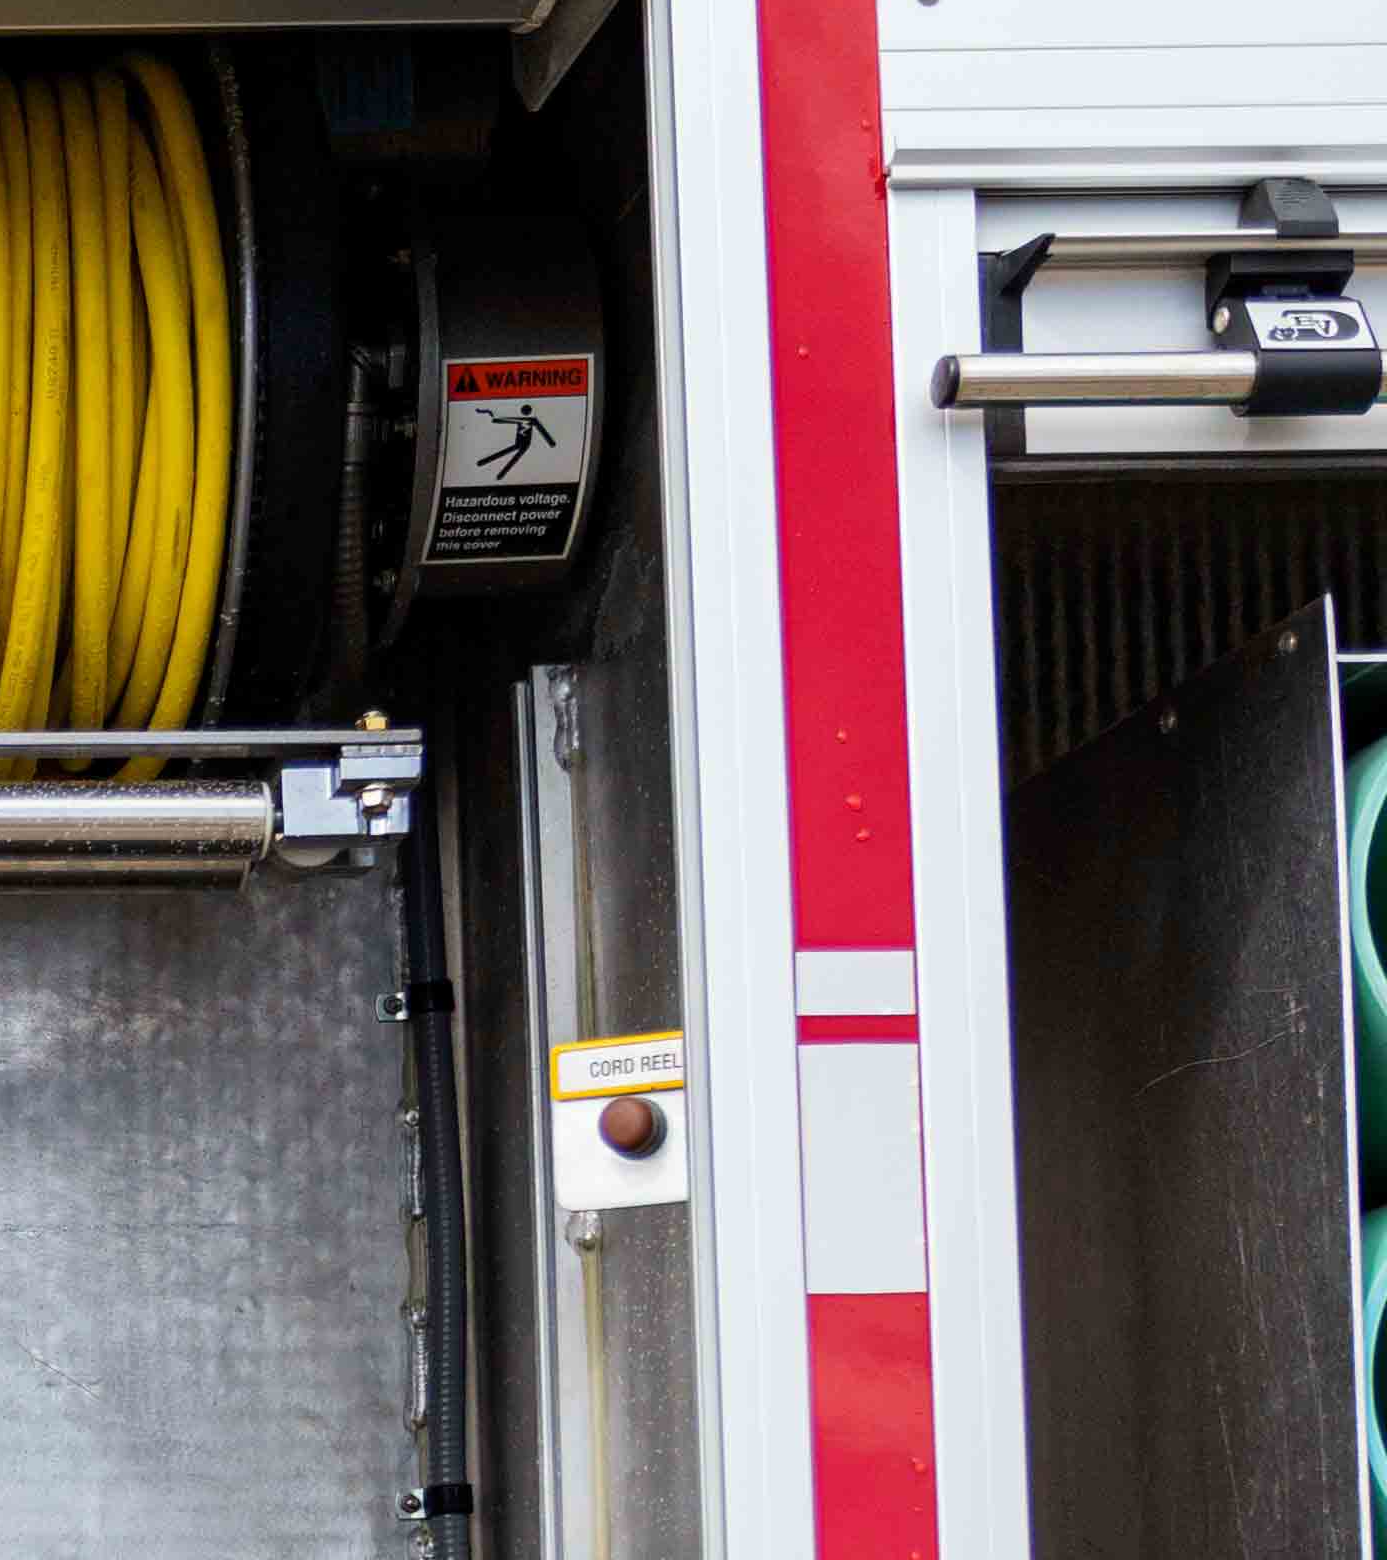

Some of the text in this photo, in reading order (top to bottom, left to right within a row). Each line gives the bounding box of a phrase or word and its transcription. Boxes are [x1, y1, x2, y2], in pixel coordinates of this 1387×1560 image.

[485, 368, 582, 389] WARNING
[445, 493, 570, 508] Hazardous voltage.
[442, 509, 562, 523] Disconnect power
[438, 524, 547, 538] before removing
[589, 1052, 683, 1078] CORD REEL
